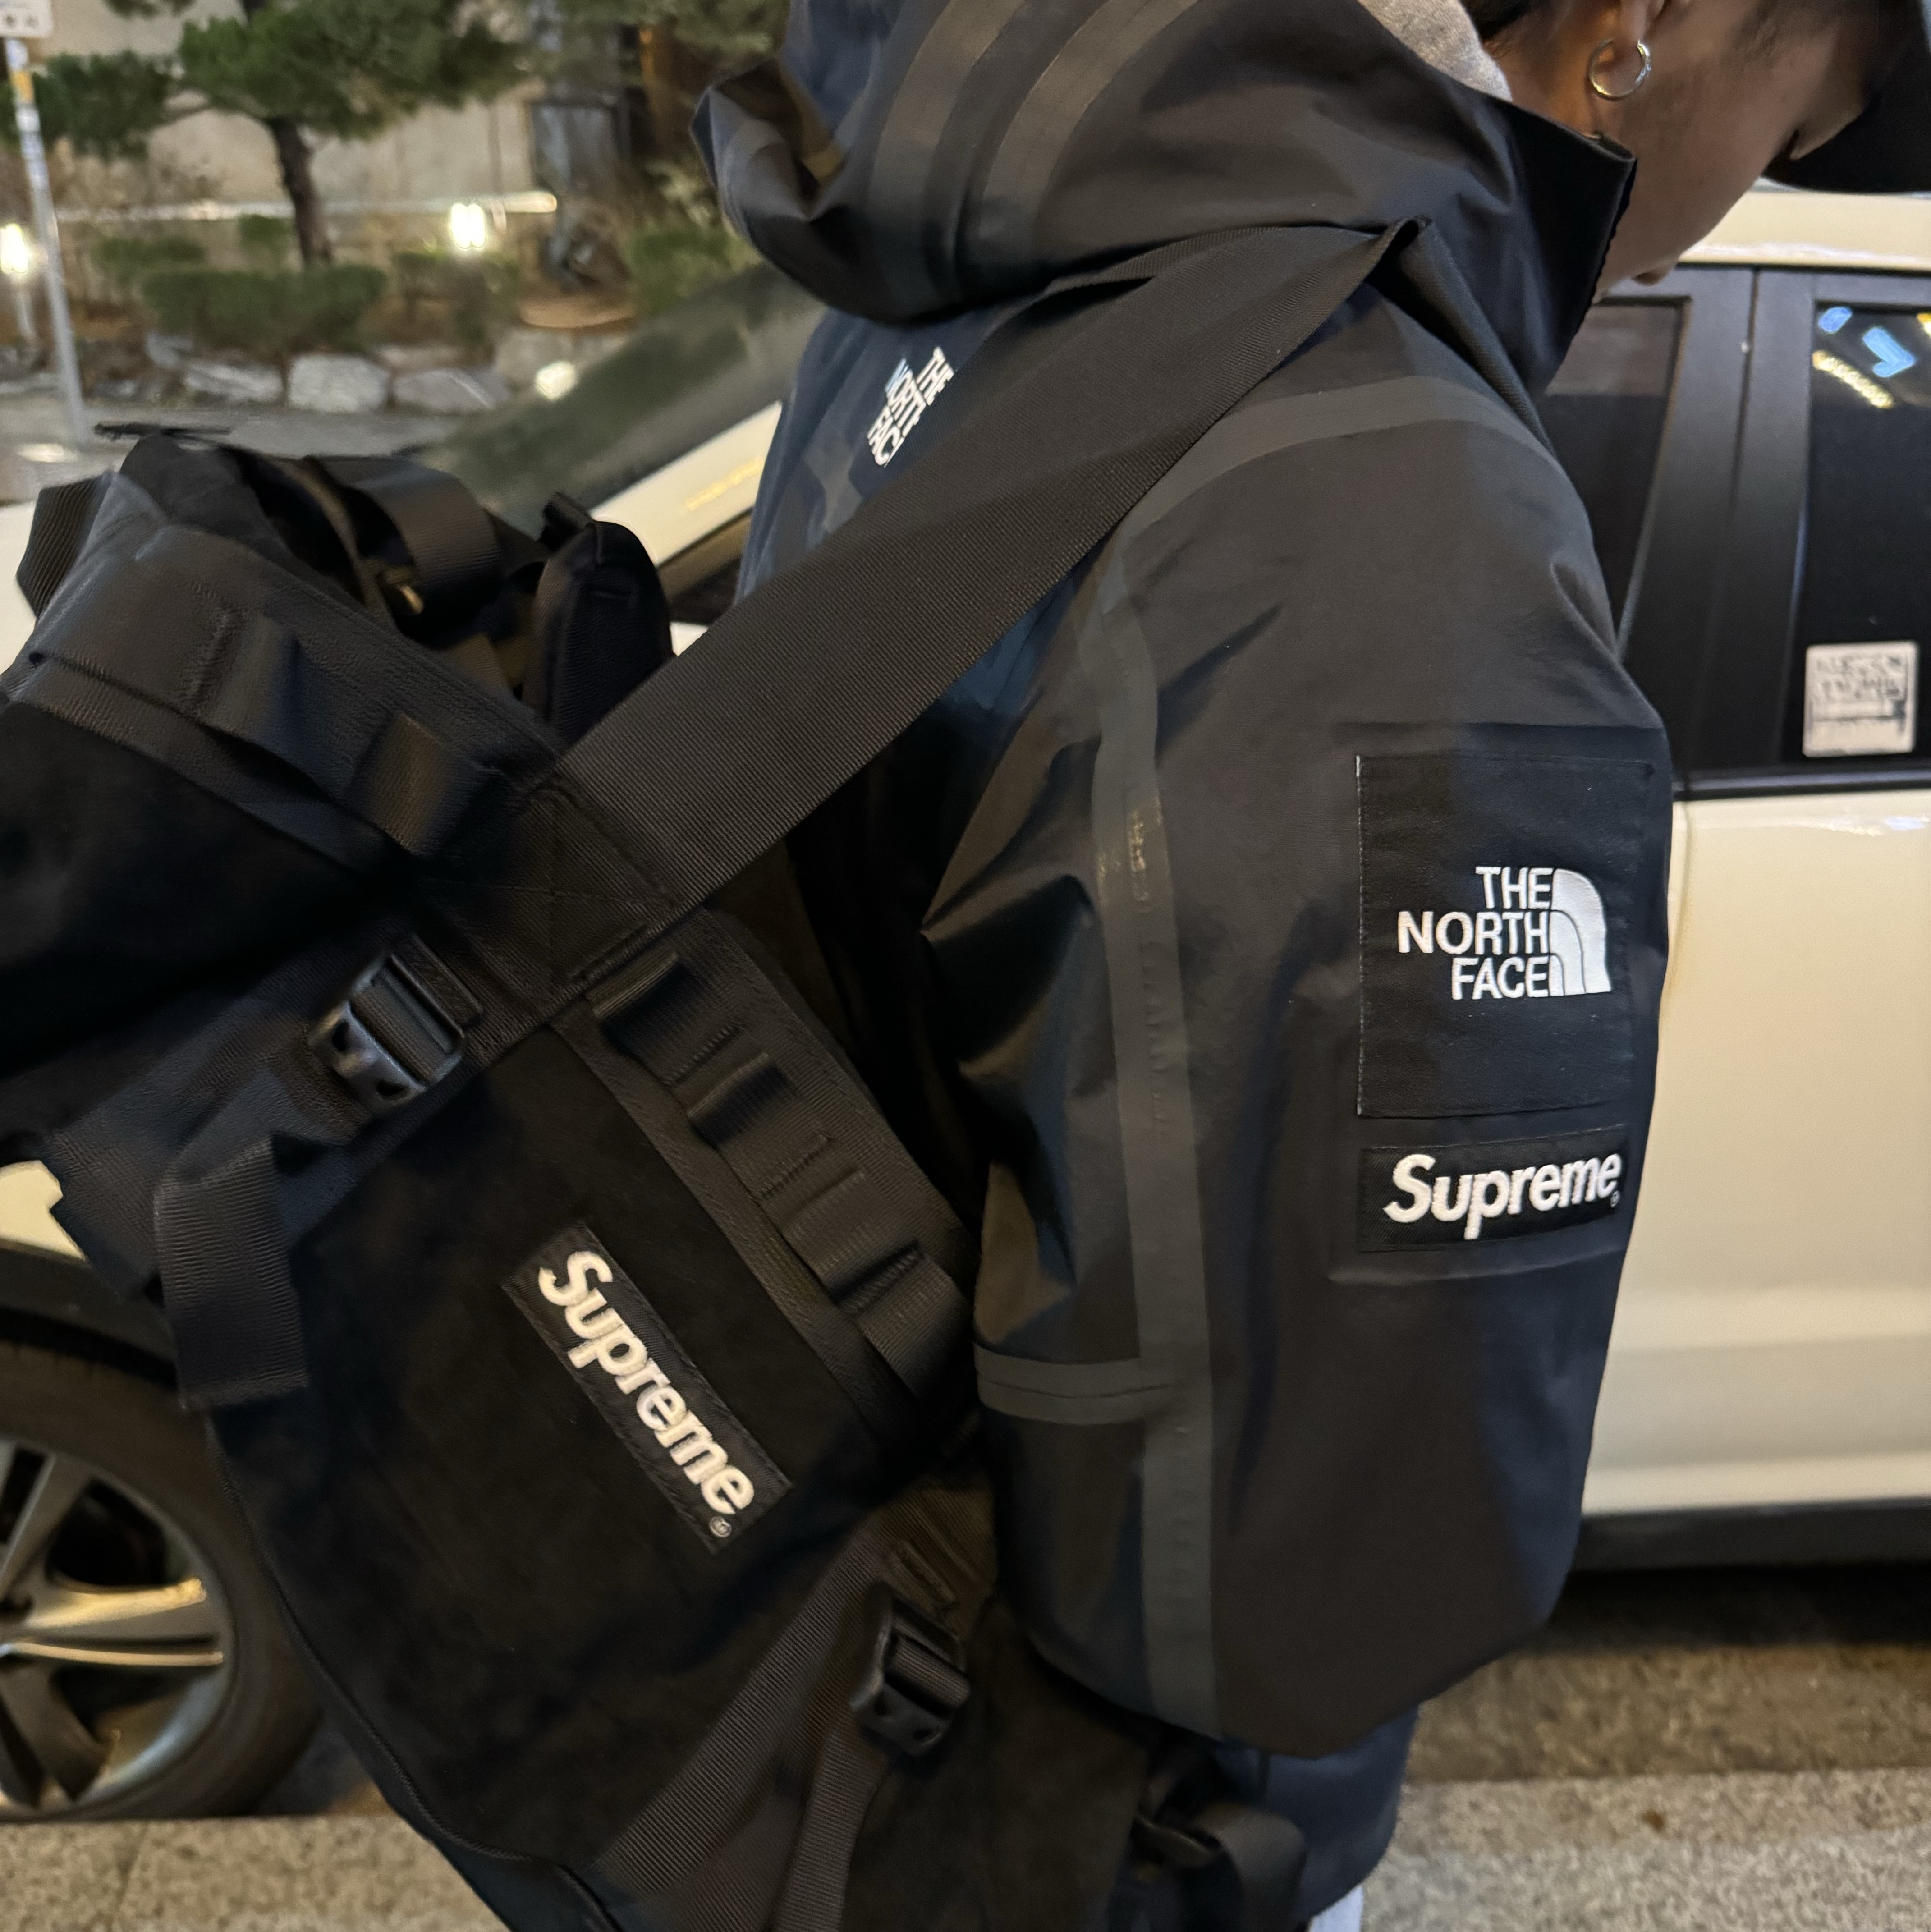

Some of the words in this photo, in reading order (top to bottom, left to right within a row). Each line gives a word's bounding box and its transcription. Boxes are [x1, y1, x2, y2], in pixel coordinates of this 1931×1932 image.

[916, 346, 954, 406] THE
[1475, 866, 1553, 909] THE
[1398, 911, 1549, 955] NORTH
[1451, 956, 1550, 1000] FACE
[1383, 1153, 1622, 1240] Supreme
[538, 1251, 754, 1514] Supreme
